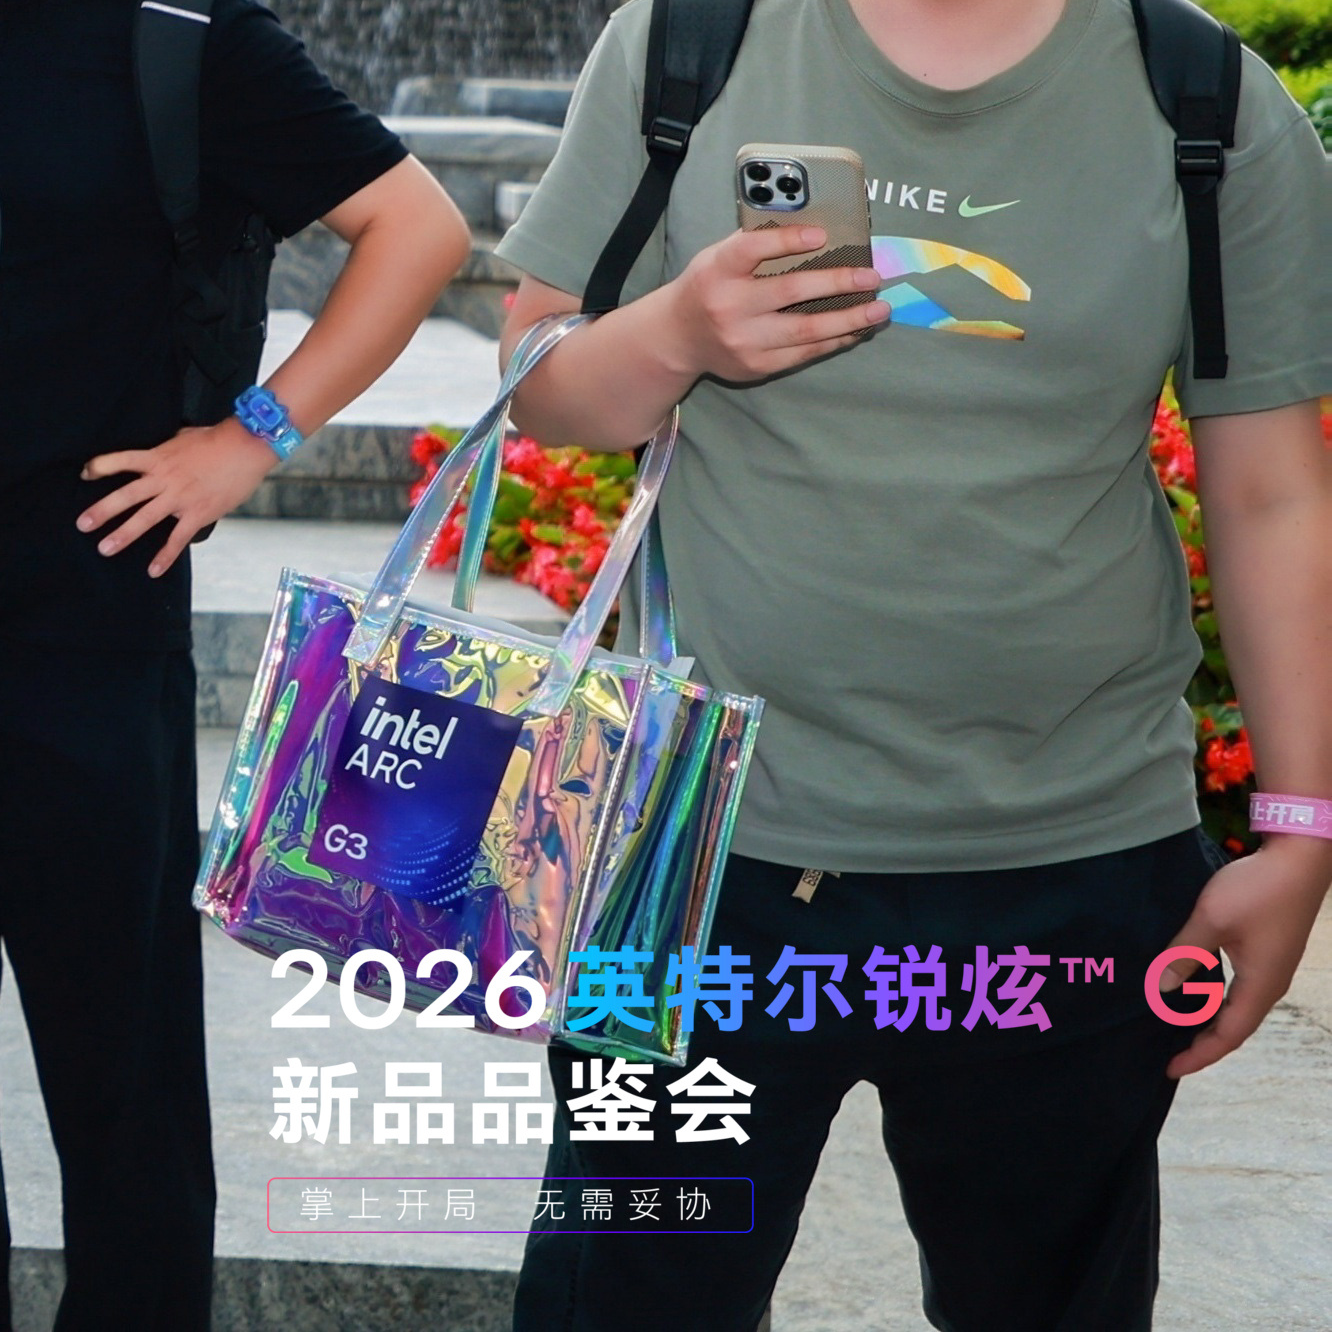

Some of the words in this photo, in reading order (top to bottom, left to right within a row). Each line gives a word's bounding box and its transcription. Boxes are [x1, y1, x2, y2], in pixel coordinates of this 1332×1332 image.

[865, 178, 947, 214] NIKE
[360, 695, 458, 760] intel
[344, 743, 422, 790] ARC
[324, 824, 368, 860] G3
